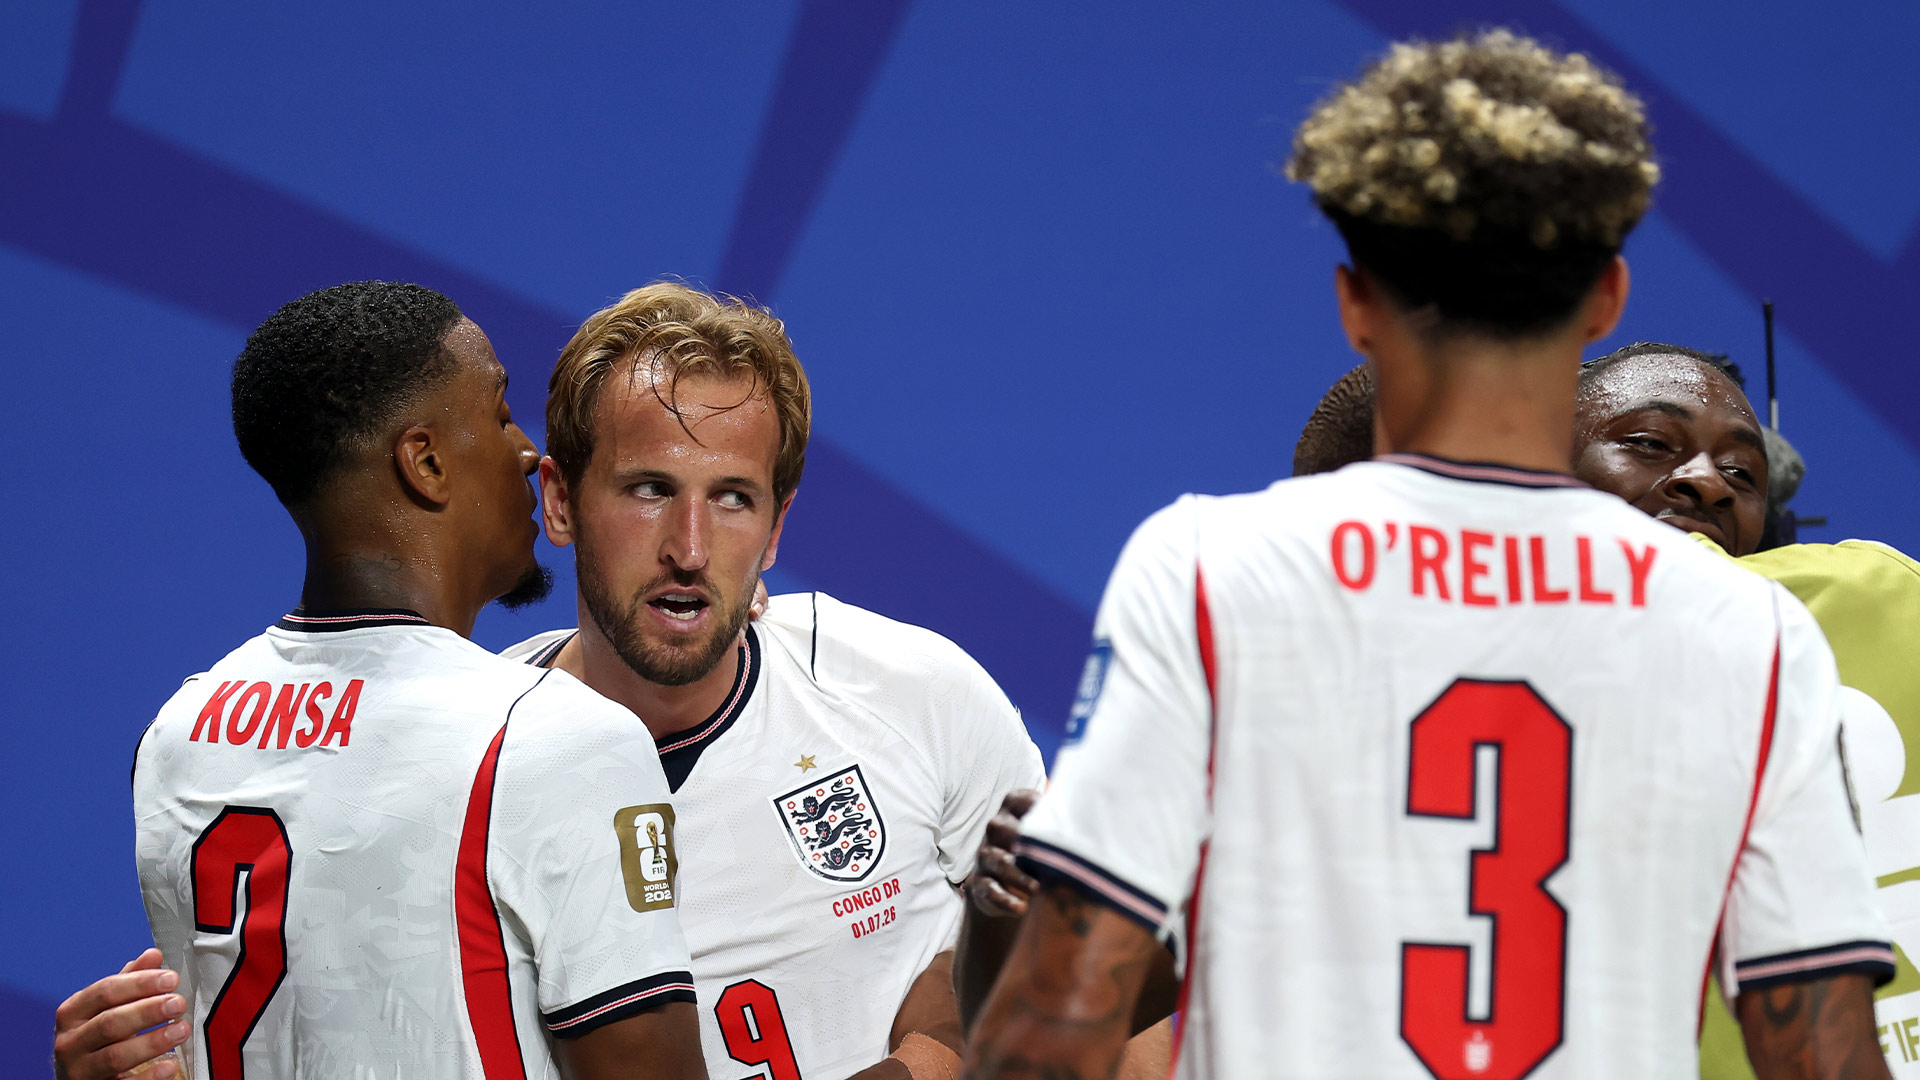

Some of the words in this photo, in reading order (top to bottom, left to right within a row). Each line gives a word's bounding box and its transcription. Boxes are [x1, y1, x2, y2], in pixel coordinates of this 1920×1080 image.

[1330, 520, 1658, 607] O'REILLY
[189, 679, 365, 750] KONSA
[832, 886, 882, 917] CONGO
[882, 878, 901, 899] DR
[851, 905, 896, 939] 01.07.26
[1399, 677, 1574, 1080] 3
[190, 805, 293, 1080] 2
[713, 978, 802, 1080] 9
